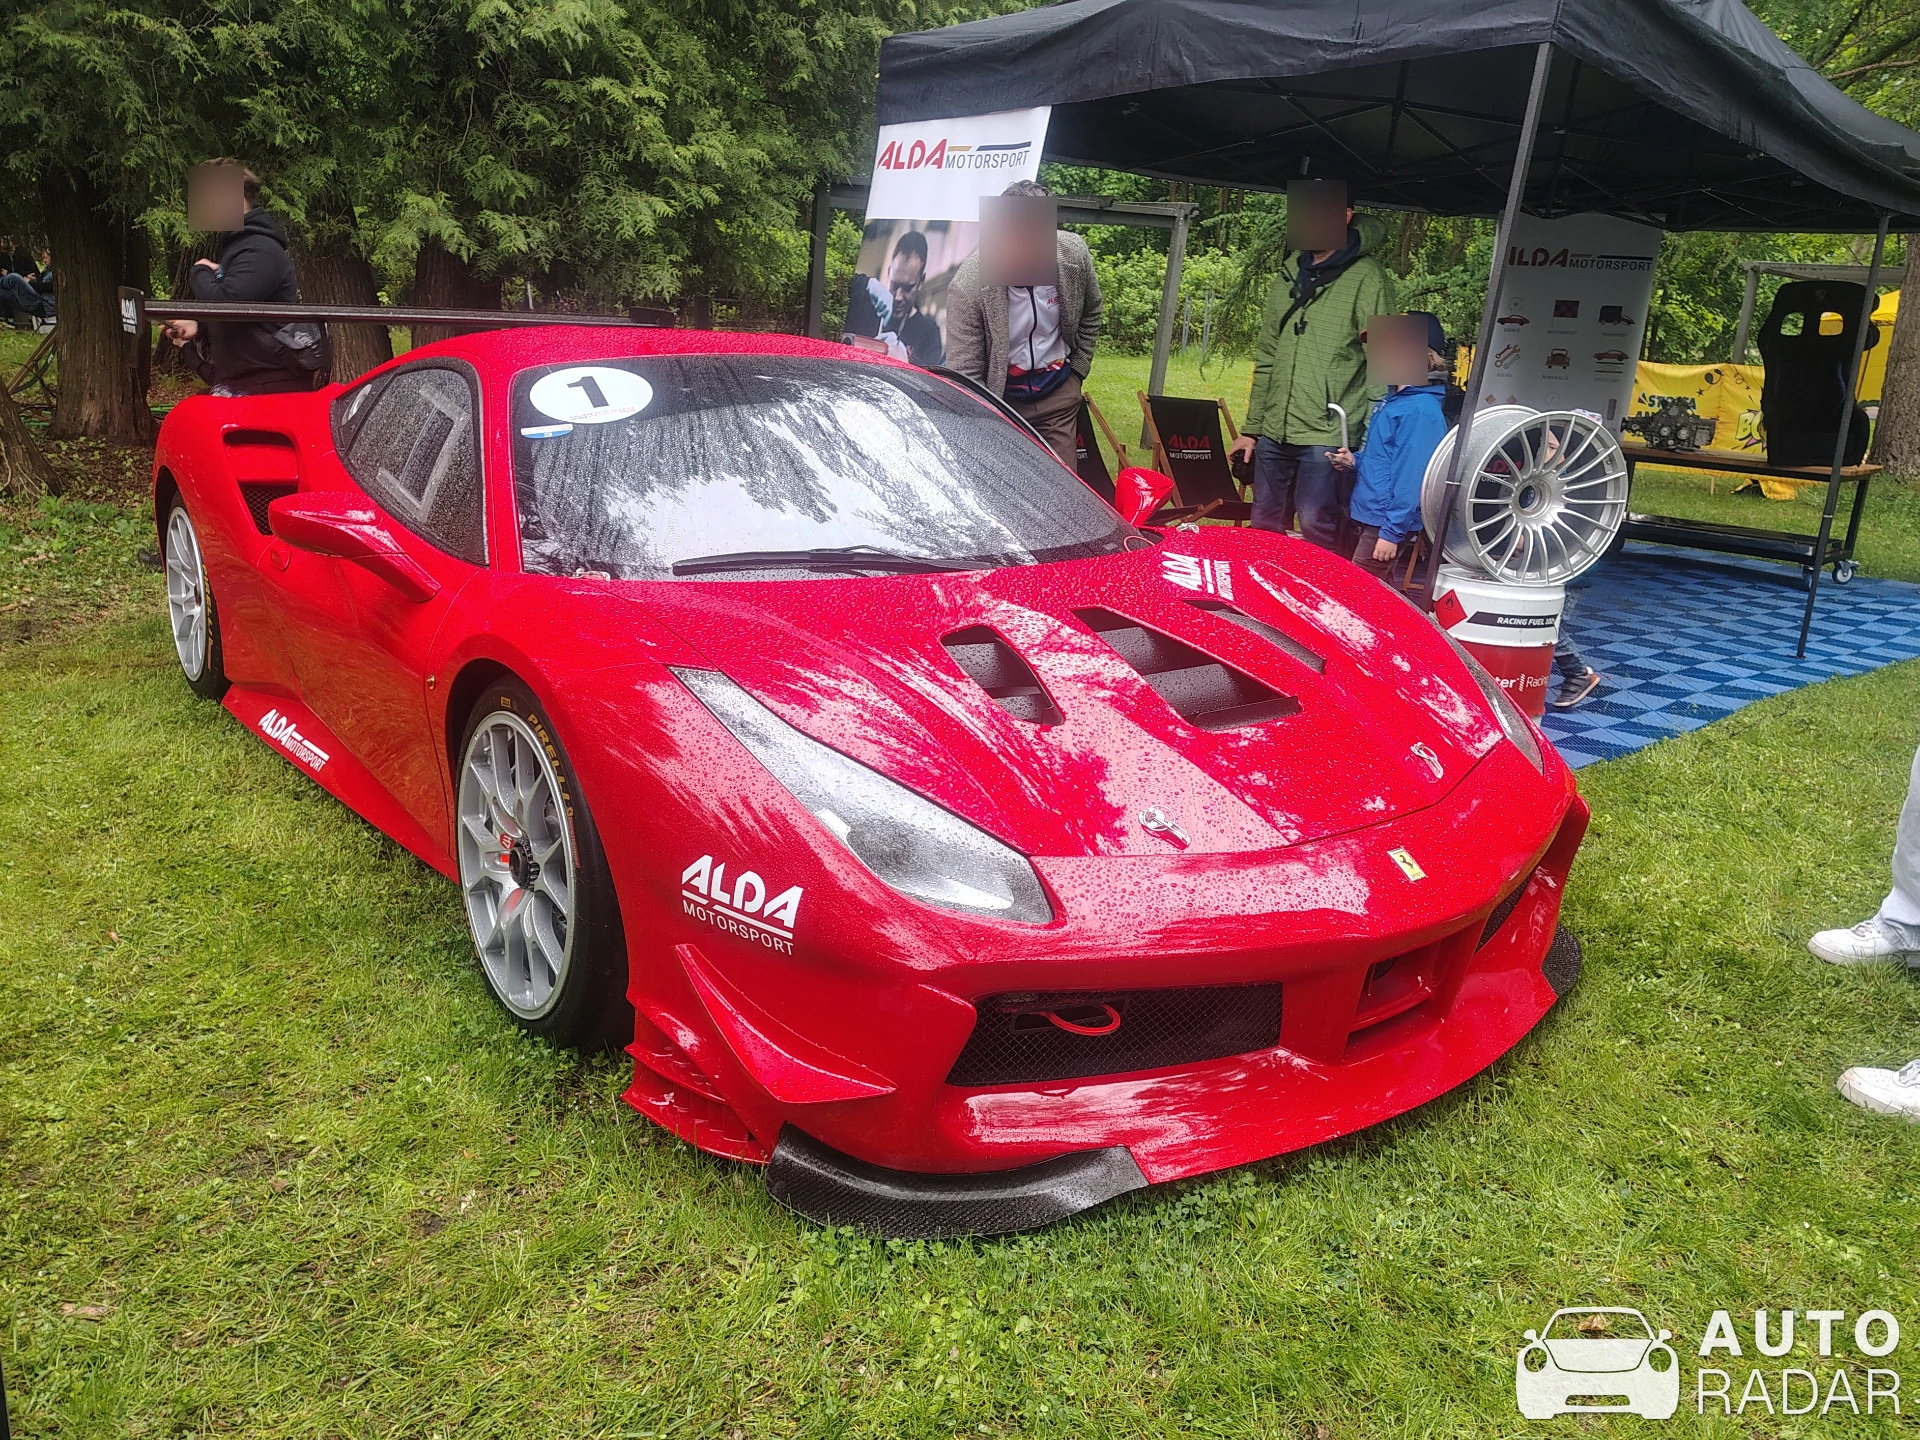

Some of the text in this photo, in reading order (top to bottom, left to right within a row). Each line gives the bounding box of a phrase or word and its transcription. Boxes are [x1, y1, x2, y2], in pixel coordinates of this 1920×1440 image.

[877, 139, 1031, 170] ALDA MOTORSPORT
[1569, 259, 1653, 272] MOTORSPORT
[566, 376, 610, 409] 1
[1168, 434, 1210, 449] ALDA
[1169, 452, 1212, 460] MOTORSPORT
[1496, 617, 1527, 626] RACING
[1528, 618, 1545, 626] FUEL
[258, 708, 326, 773] ALDA MOTORSPORT
[527, 713, 571, 801] PIRELLI
[682, 854, 804, 929] ALDA
[682, 899, 794, 956] MOTORSPORT
